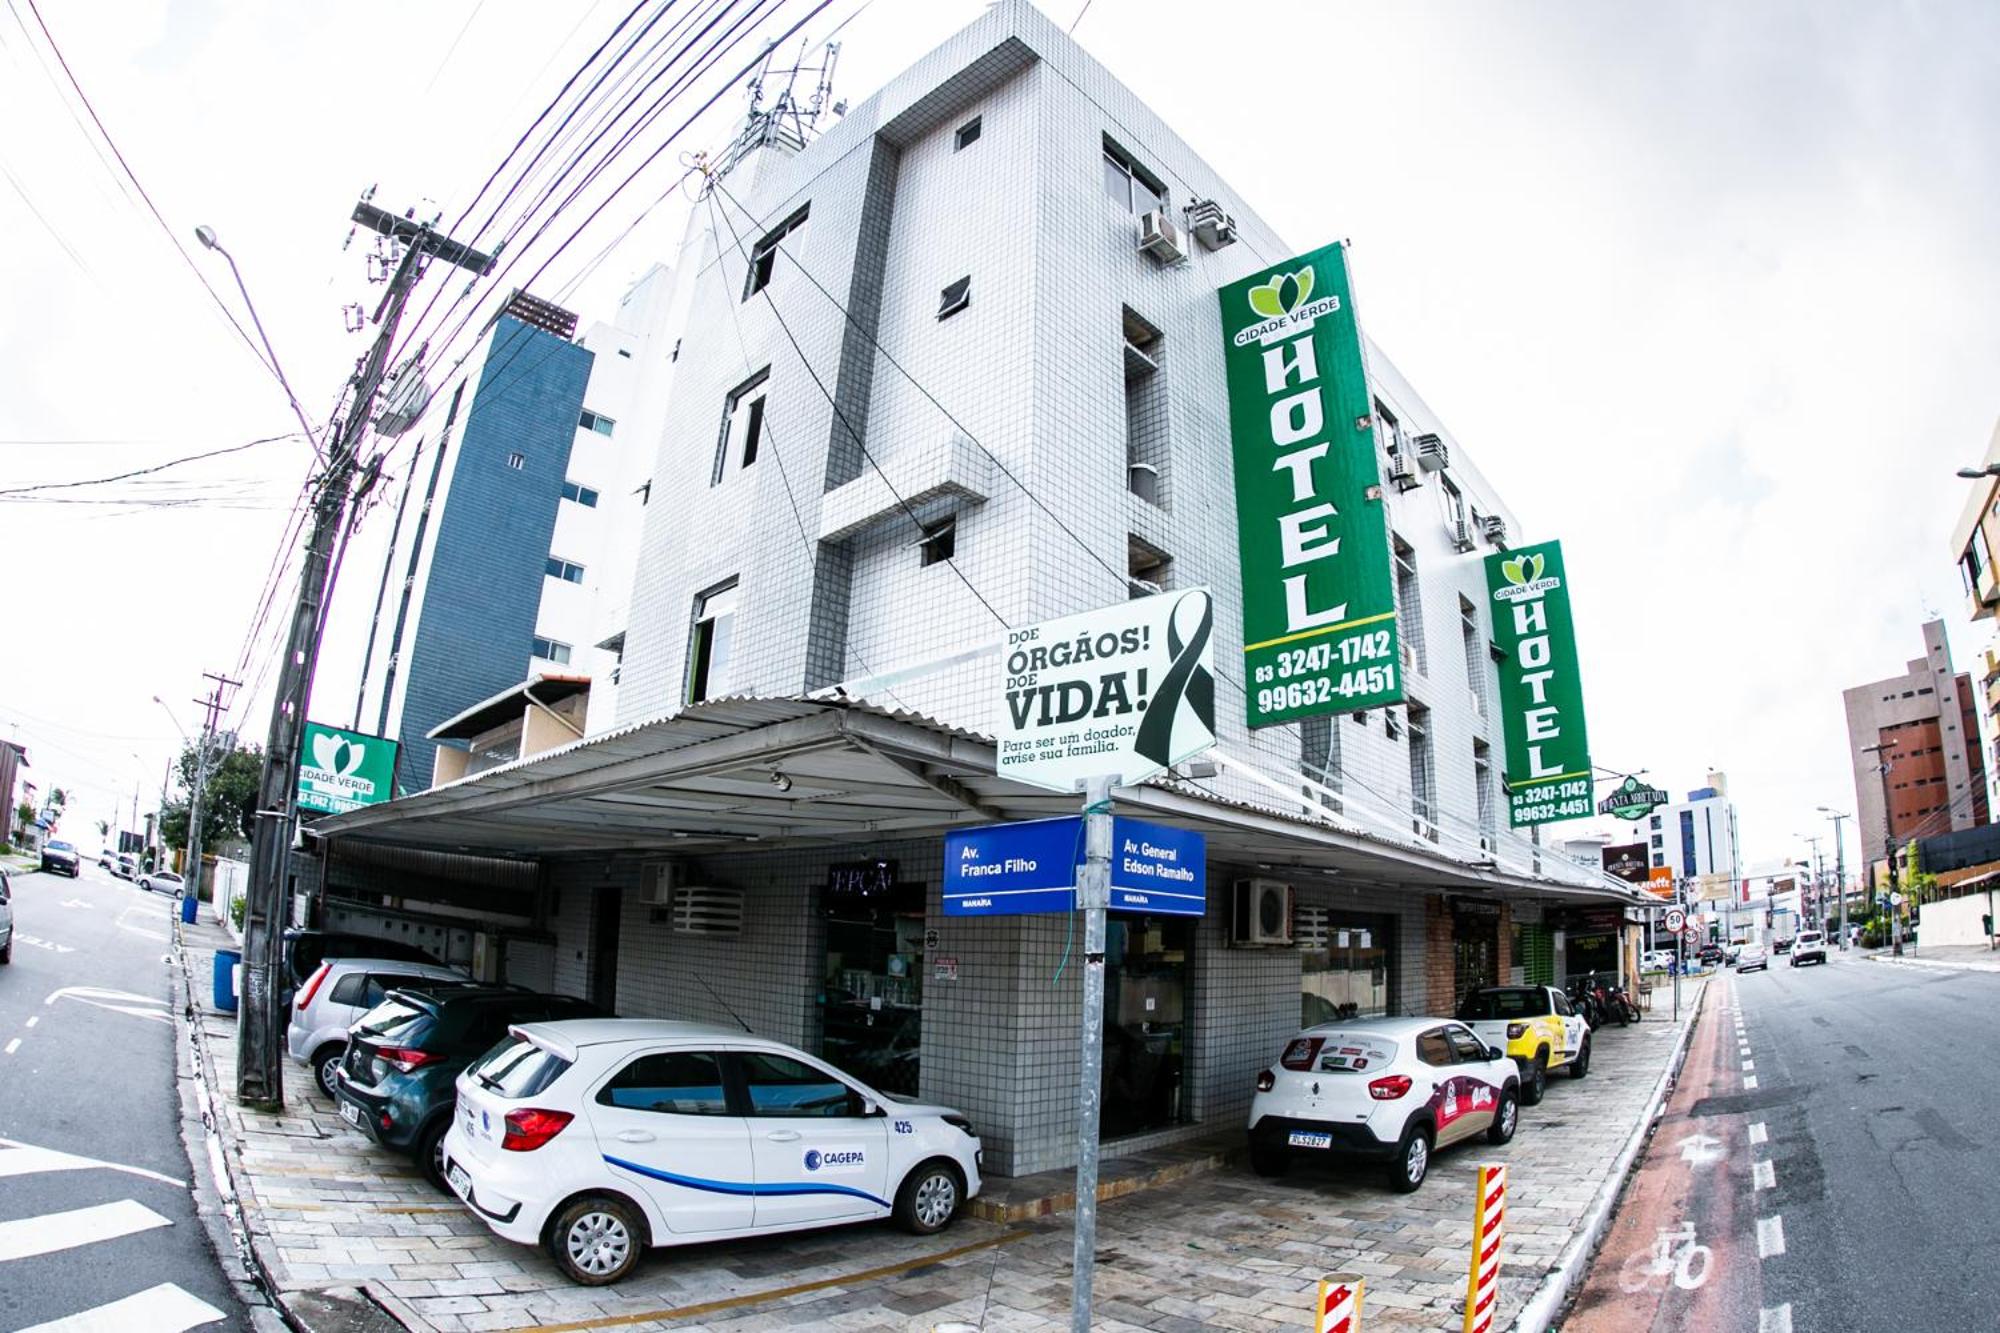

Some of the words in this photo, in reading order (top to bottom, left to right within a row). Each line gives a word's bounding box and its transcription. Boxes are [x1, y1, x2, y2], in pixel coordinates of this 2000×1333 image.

[1236, 319, 1287, 345] CIDADE
[1290, 297, 1338, 325] VERDE
[1261, 334, 1348, 632] HOTEL
[1495, 586, 1527, 599] CIDADE
[1528, 579, 1558, 592] VERDE
[1008, 628, 1039, 646] DOE
[1007, 625, 1150, 676] ÓRGÃOS!
[1255, 665, 1274, 683] 83
[1277, 630, 1391, 679] 3247-1742
[1006, 673, 1038, 690] DOE
[1258, 664, 1395, 714] 99632-4451
[1511, 599, 1565, 780] HOTEL
[1005, 667, 1148, 731] VIDA!
[1003, 739, 1032, 753] Para
[1035, 737, 1055, 749] ser
[1059, 733, 1080, 745] um
[1083, 725, 1136, 742] doador,
[1002, 752, 1036, 766] avise
[1039, 750, 1063, 761] sua
[301, 769, 336, 785] IDADE
[337, 776, 373, 793] VERDE
[1525, 780, 1588, 804] 3247-1742
[1514, 798, 1590, 823] 99632-4451
[961, 845, 980, 860] Av.
[1123, 839, 1140, 855] Av.
[1141, 842, 1177, 861] General
[1004, 858, 1037, 874] Filho
[1123, 857, 1154, 876] Edson
[1156, 863, 1194, 882] Ramalho
[1670, 915, 1681, 925] 50
[894, 1120, 913, 1134] 425
[823, 1151, 865, 1164] CAGEPA
